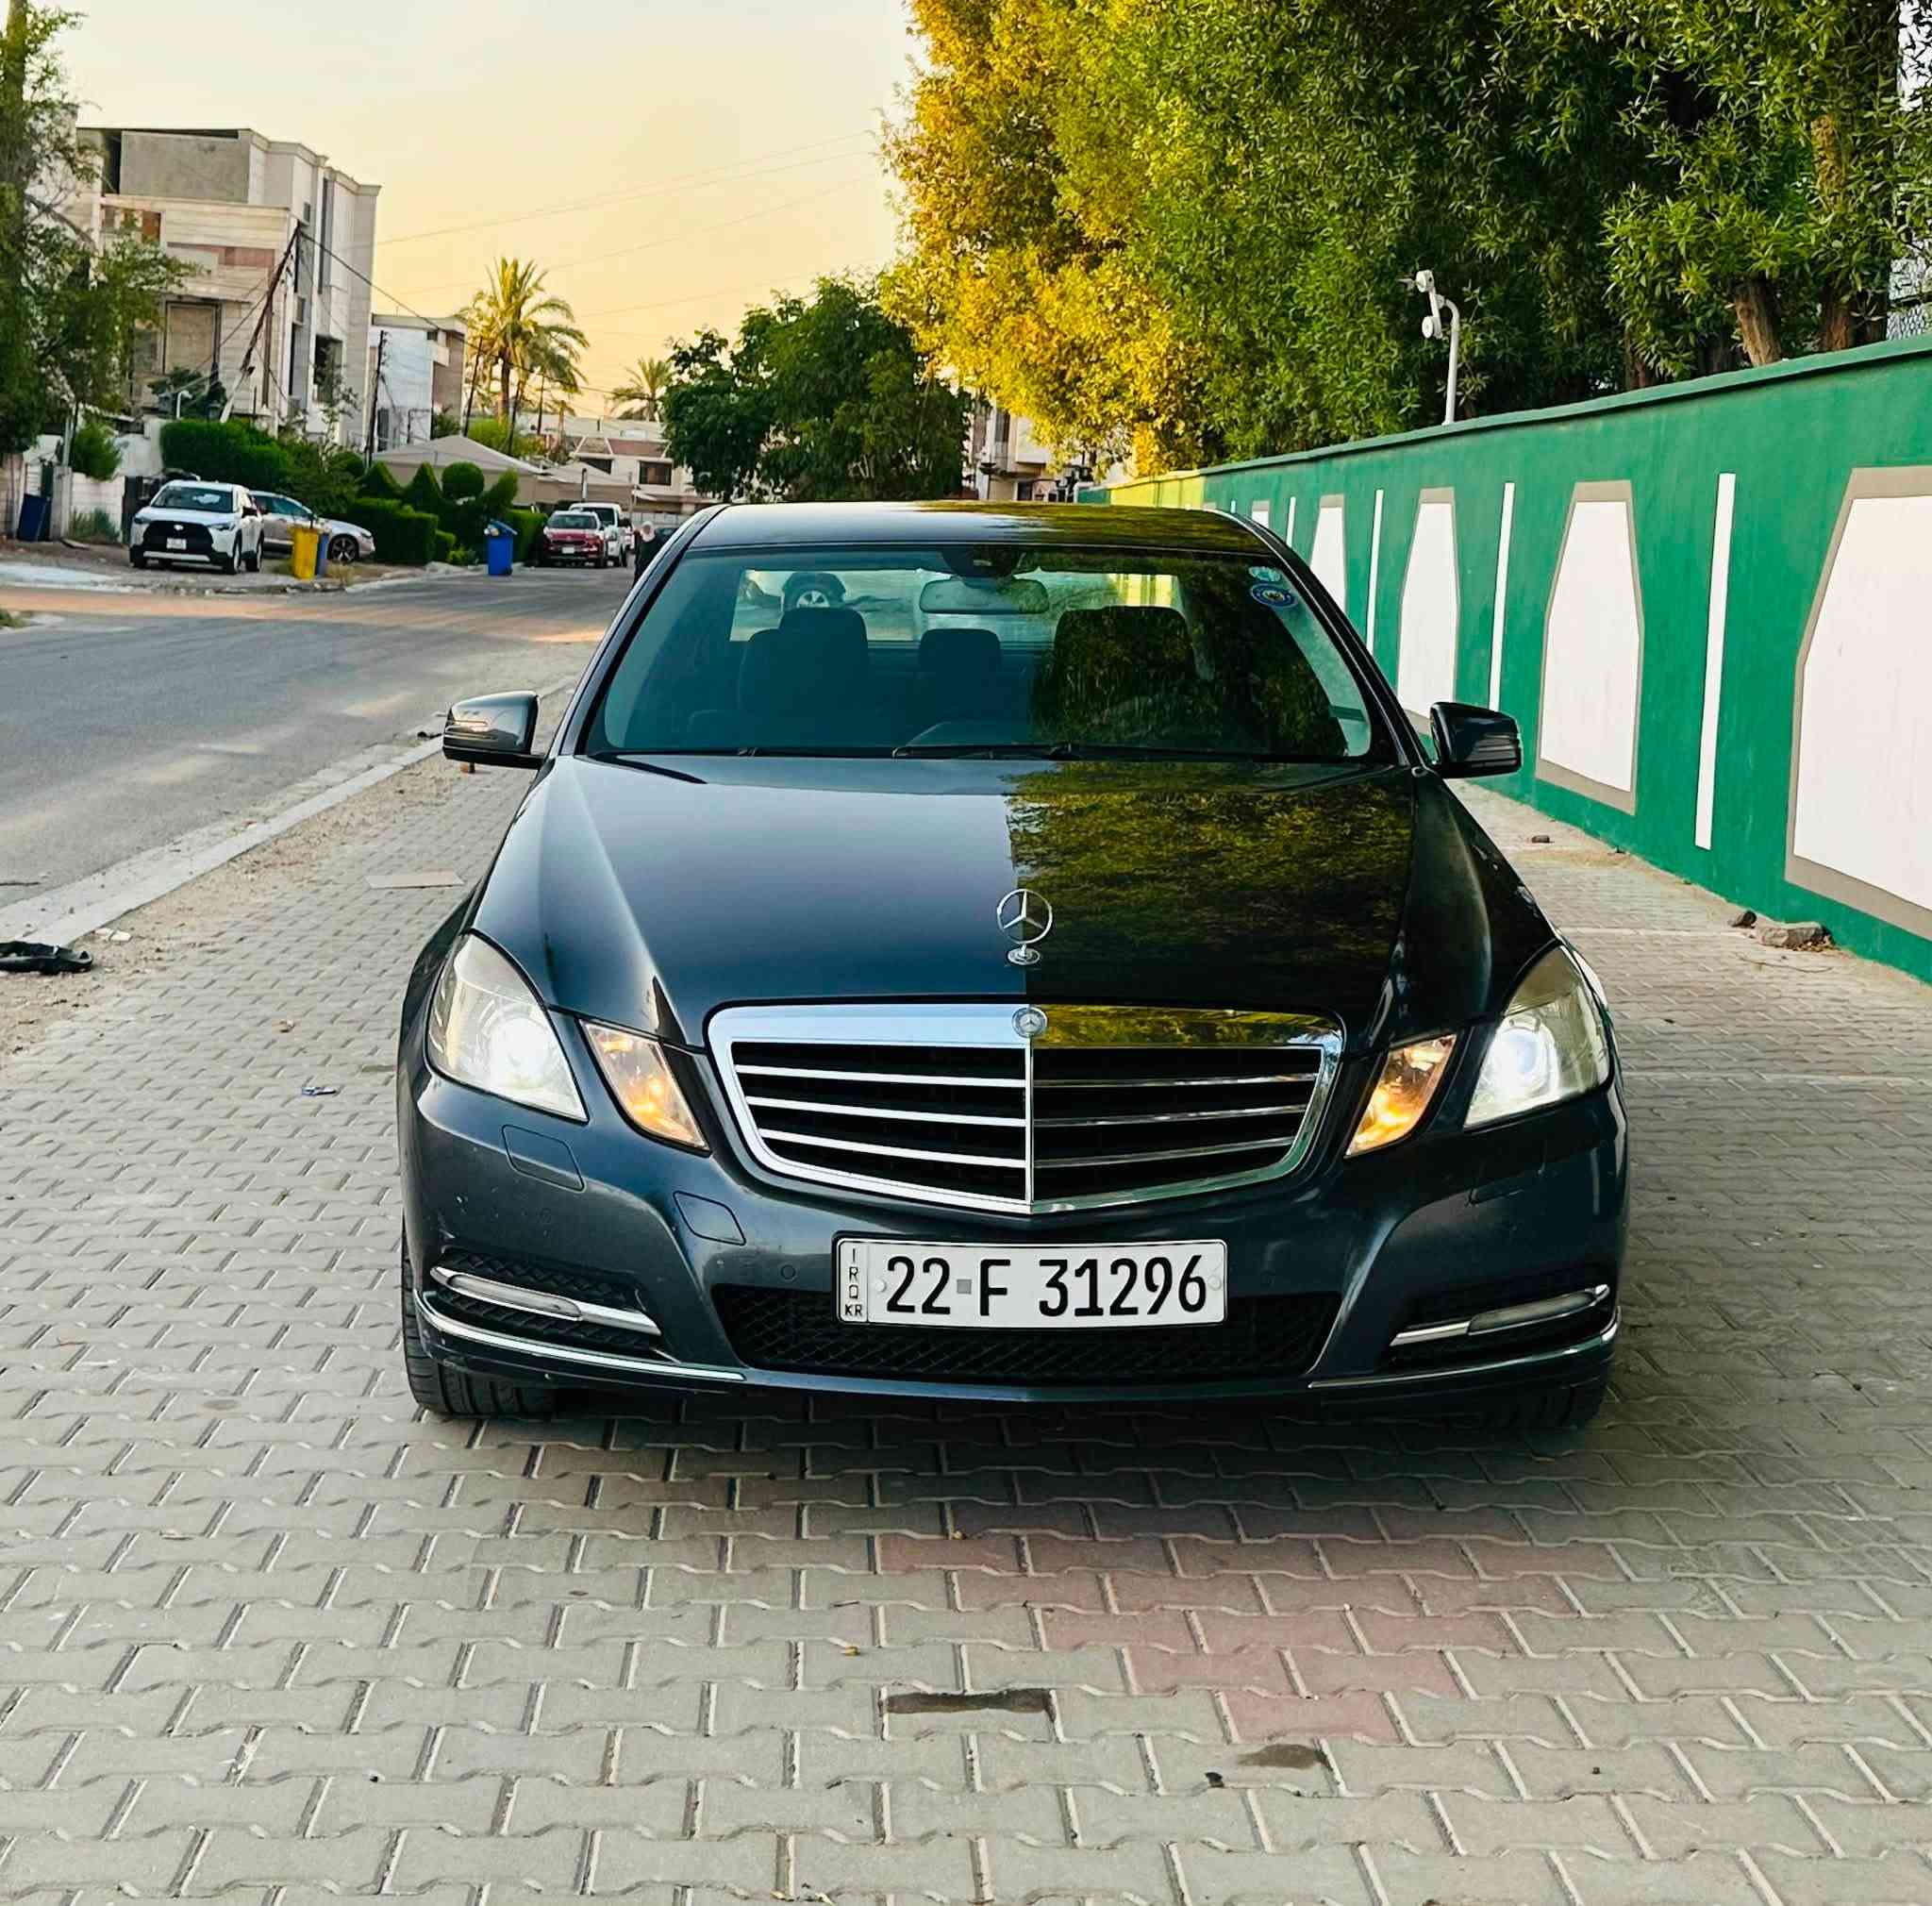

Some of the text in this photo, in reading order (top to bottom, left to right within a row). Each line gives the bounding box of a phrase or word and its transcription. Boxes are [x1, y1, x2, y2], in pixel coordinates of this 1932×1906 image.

[886, 1254, 1207, 1317] 22 F 31296
[844, 1304, 863, 1316] KR
